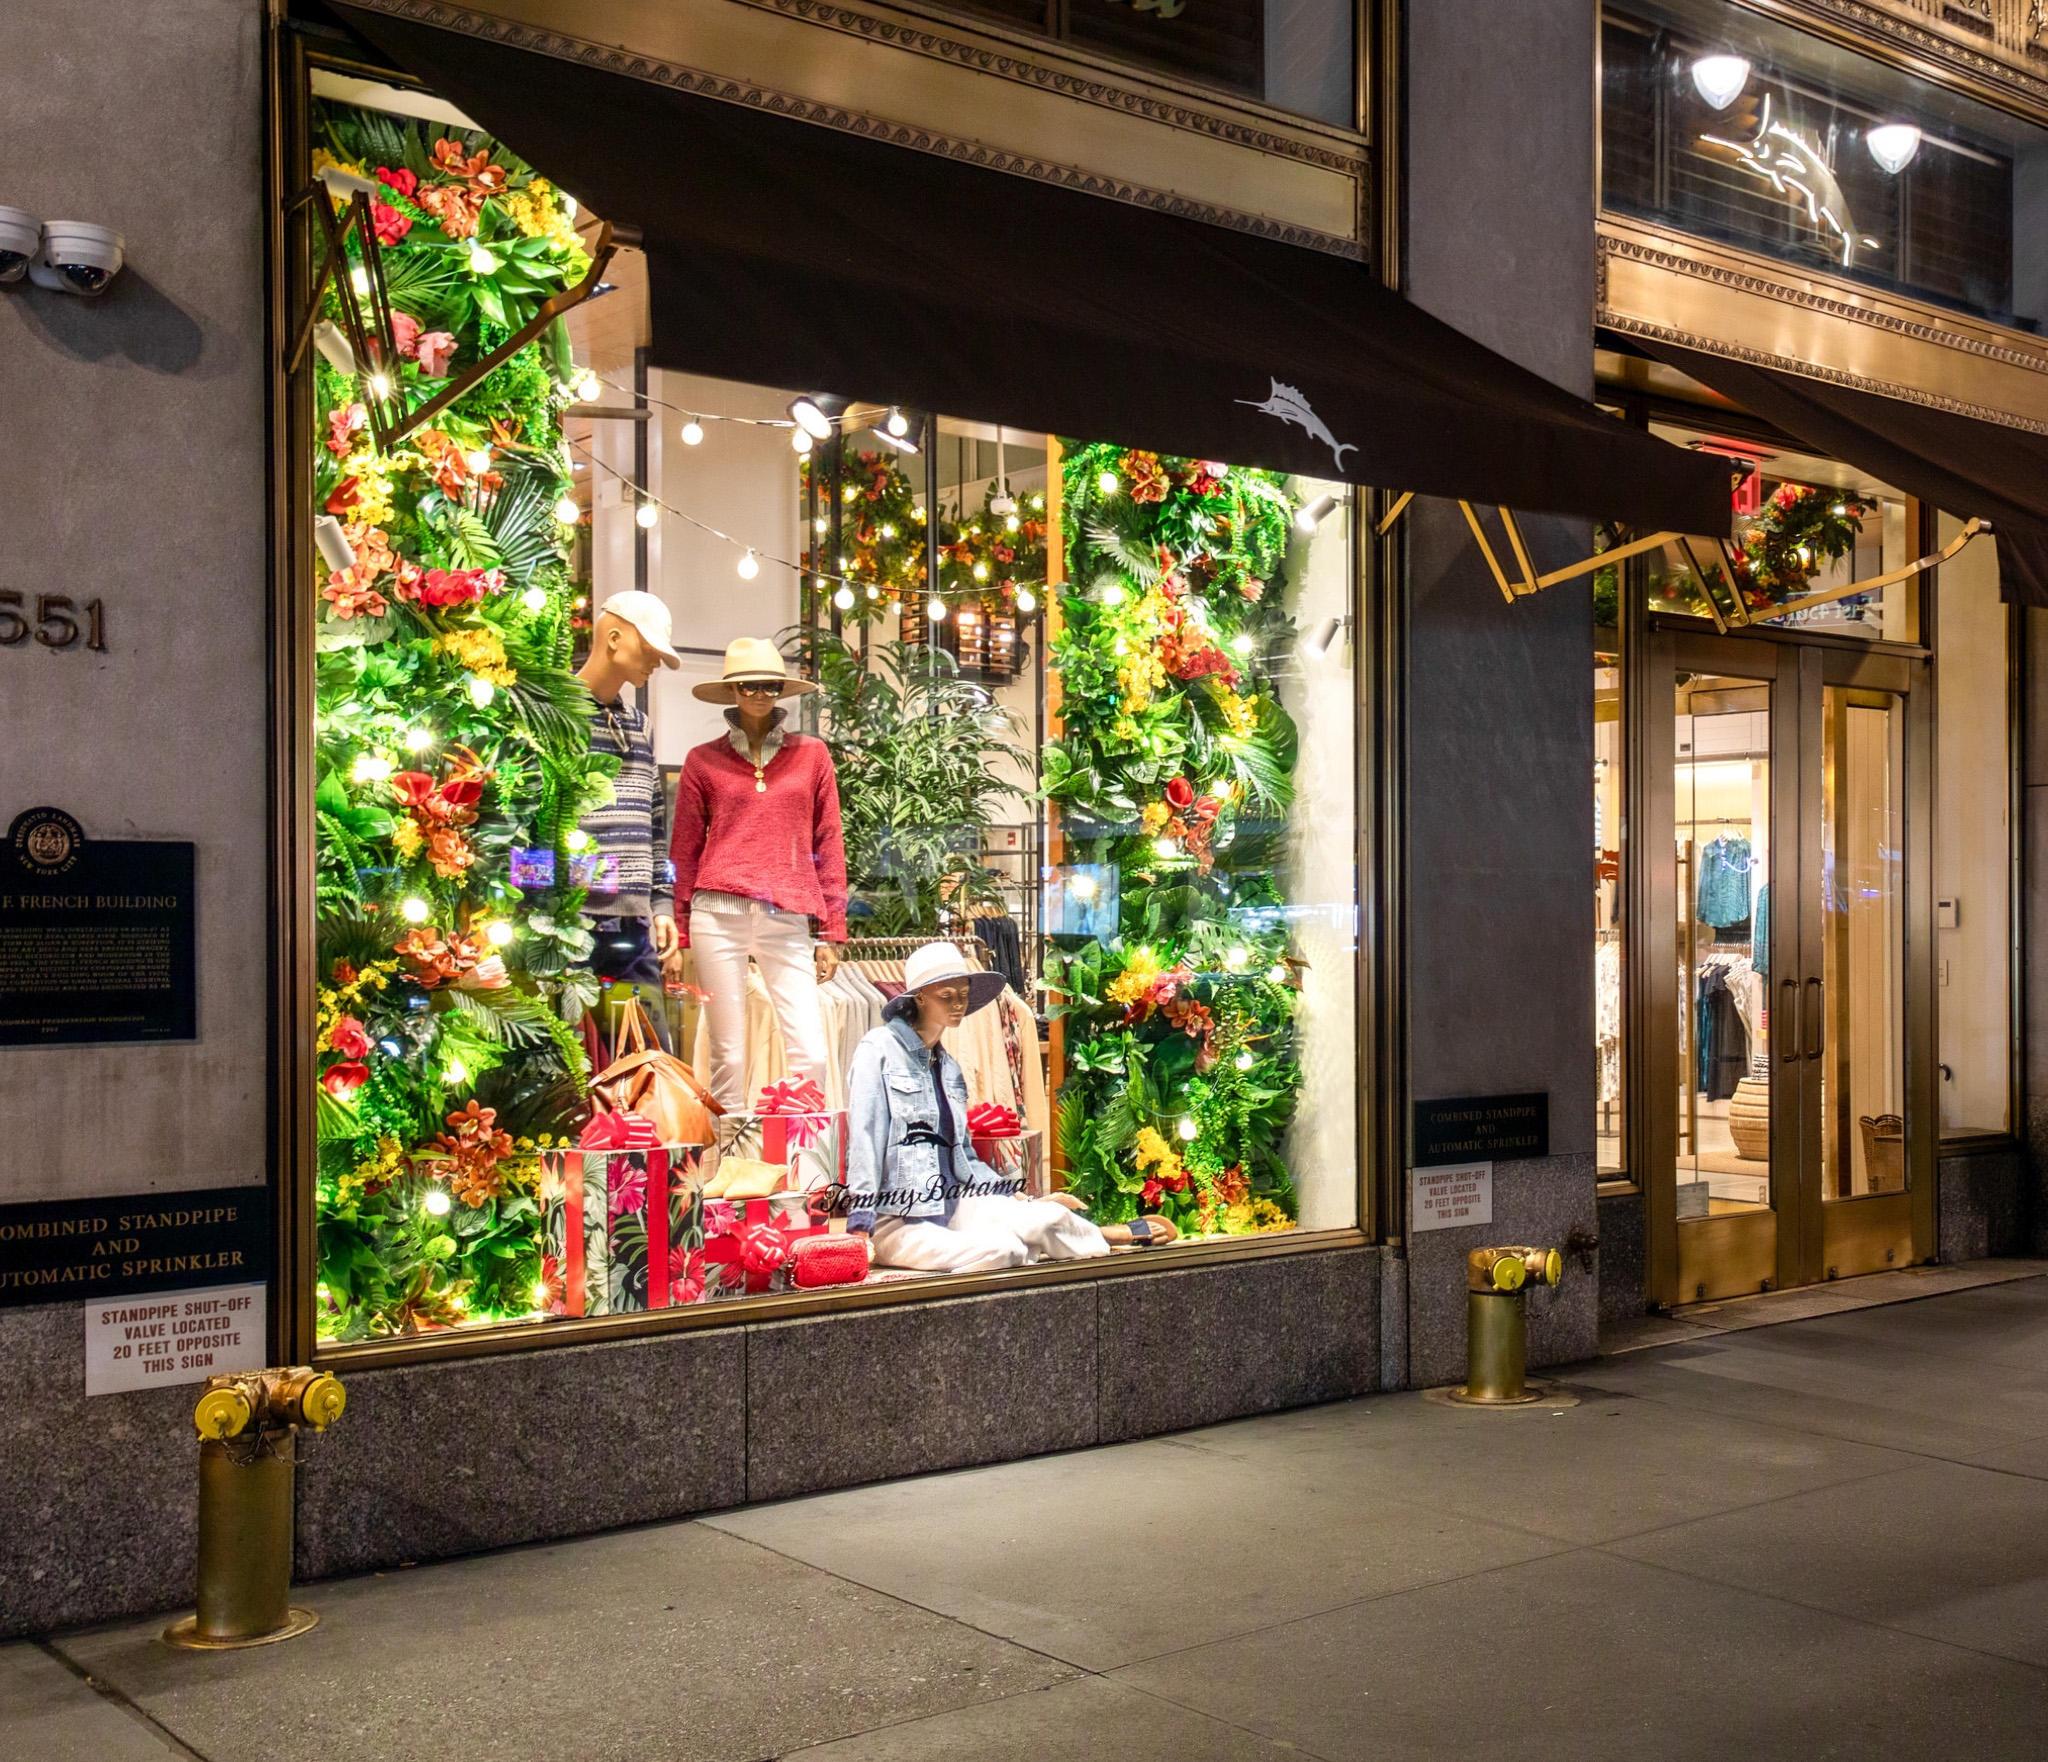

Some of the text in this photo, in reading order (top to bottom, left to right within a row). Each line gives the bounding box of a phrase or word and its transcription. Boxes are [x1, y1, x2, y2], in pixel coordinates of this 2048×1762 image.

[1766, 529, 1820, 576] 551
[0, 590, 105, 651] 551
[20, 896, 89, 909] FRENCH
[96, 896, 177, 909] BUILDING
[1430, 1106, 1537, 1124] COMBINED STANDPIPE
[1474, 1124, 1496, 1136] AND
[1428, 1135, 1539, 1154] AUTOMATIC SPRINKLER
[1419, 1170, 1486, 1186] STANDPIPE SHUT-OFF
[820, 1173, 1030, 1217] Tommy Bahama
[1429, 1183, 1477, 1197] VALVE LOCATED
[1424, 1194, 1481, 1209] 20 FEET OPPOSITE
[119, 1207, 239, 1231] STANDPIPE
[1437, 1207, 1469, 1219] THIS SIGN
[92, 1238, 141, 1256] AND
[122, 1250, 245, 1277] SPRINKLER
[102, 1296, 252, 1325] STANDPIPE SHUT-OFF
[124, 1316, 231, 1341] VALVE LOCATED
[113, 1332, 242, 1360] 20 FEET OPPOSITE
[143, 1353, 214, 1374] THIS SIGN
